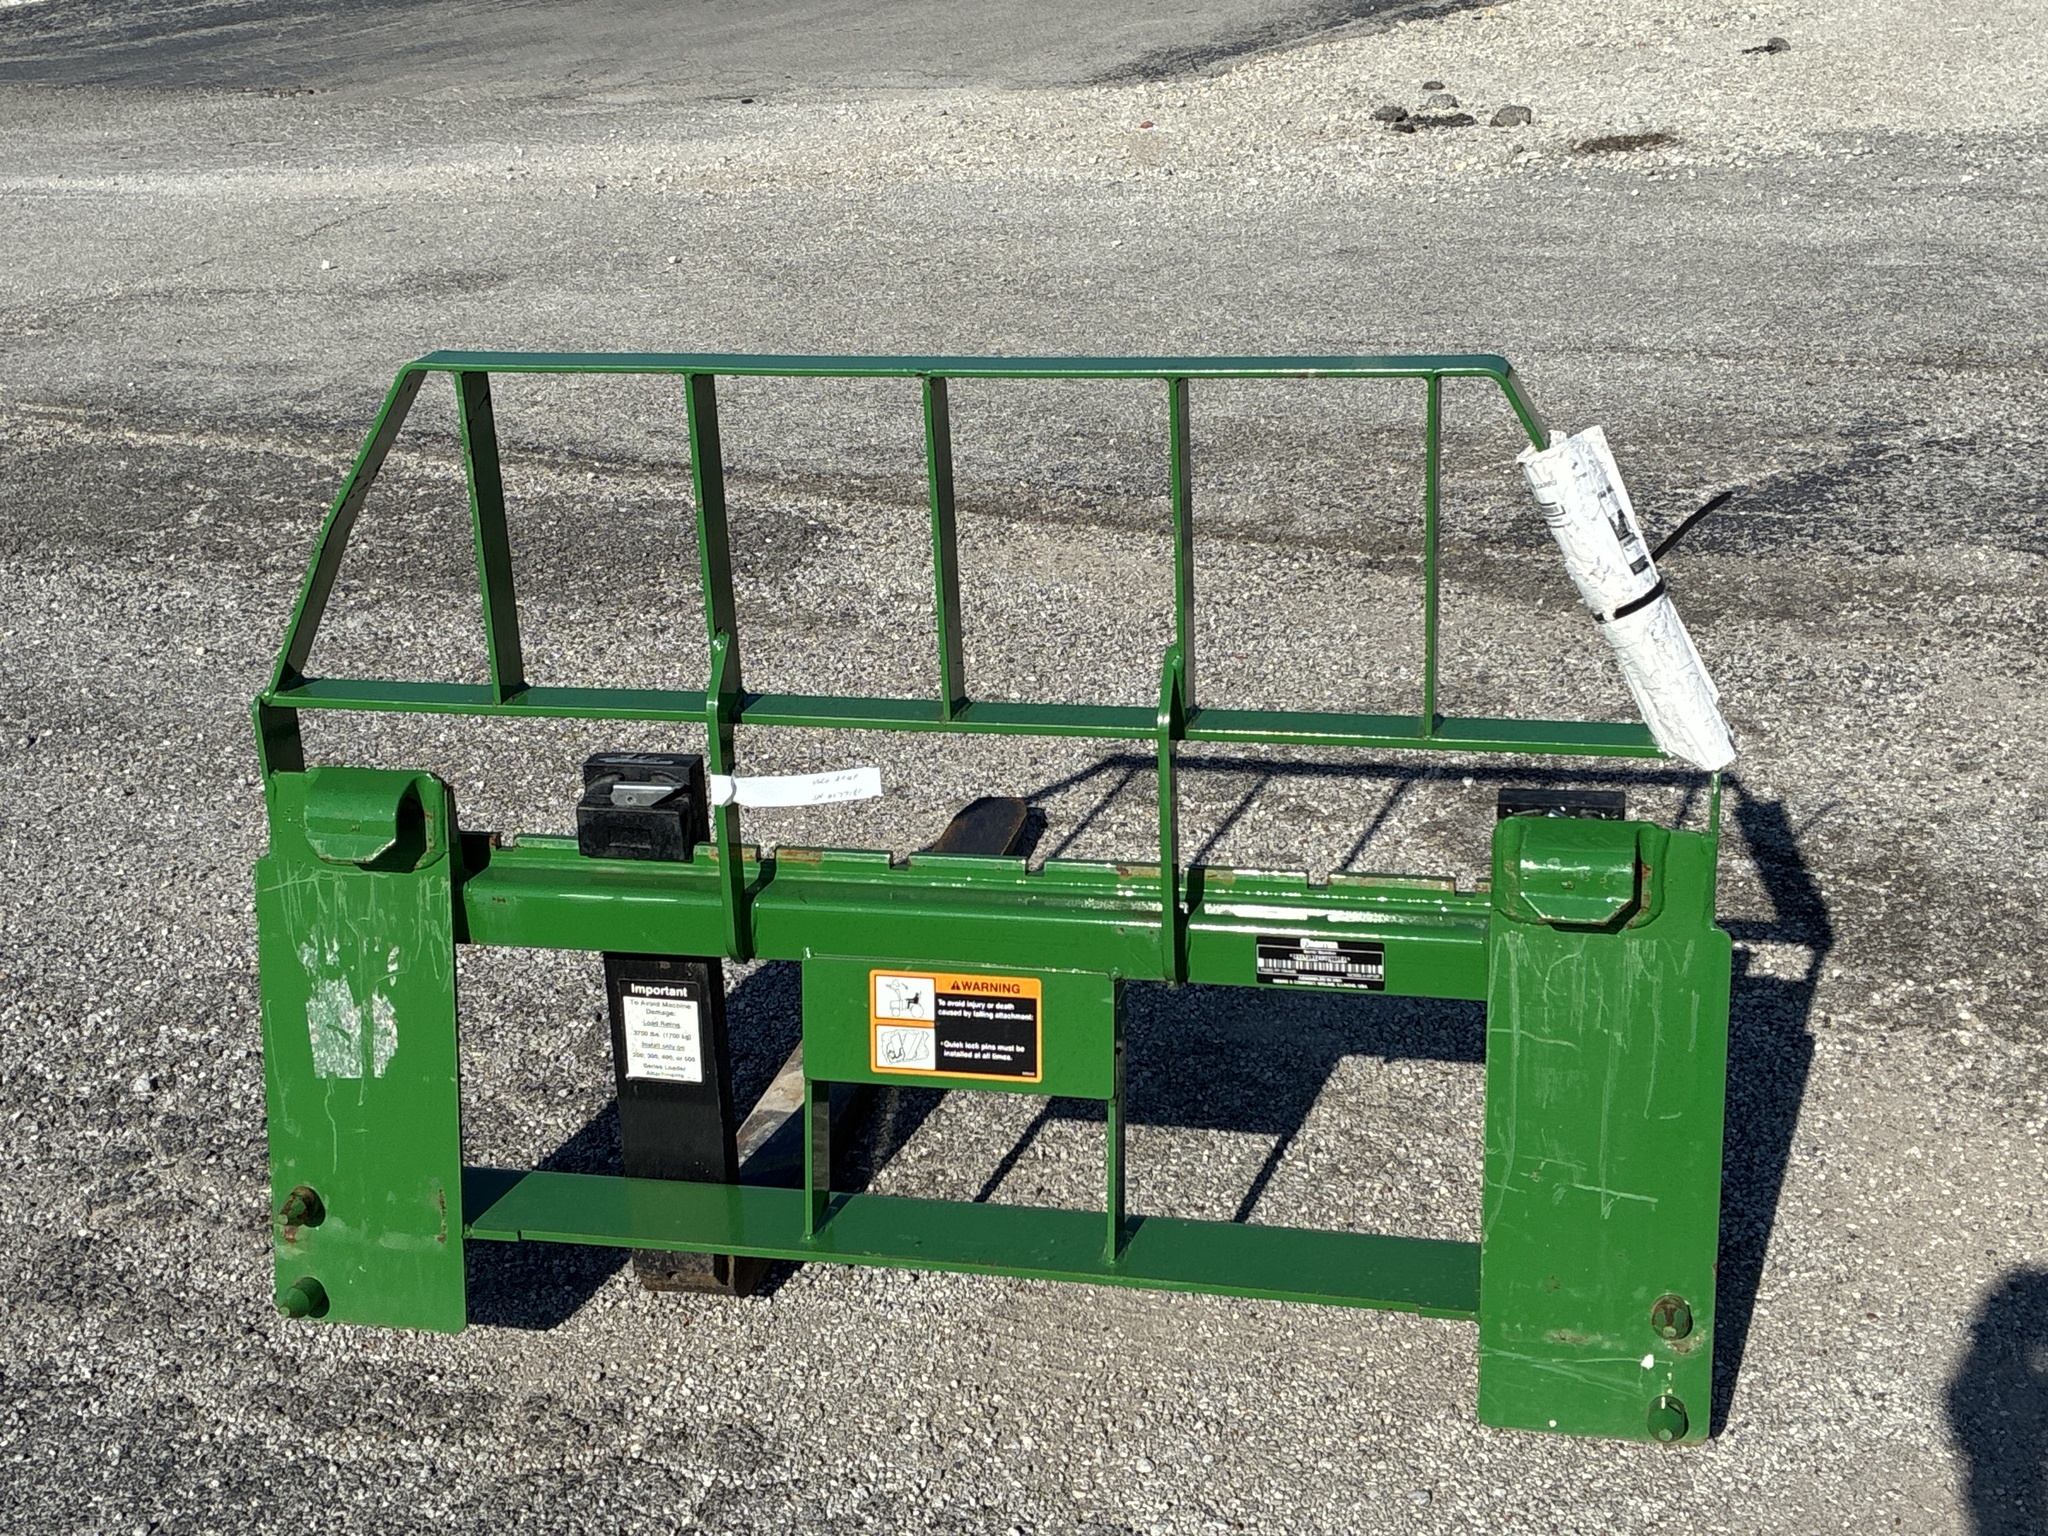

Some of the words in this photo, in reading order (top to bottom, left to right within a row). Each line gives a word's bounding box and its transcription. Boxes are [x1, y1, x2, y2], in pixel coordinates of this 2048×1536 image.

[631, 983, 688, 997] Important
[961, 981, 1021, 994] WARNING
[938, 998, 946, 1006] To
[947, 1000, 966, 1008] avoid
[967, 1001, 986, 1009] injury
[995, 1002, 1015, 1010] death
[938, 1009, 962, 1017] caused
[963, 1010, 972, 1019] by
[973, 1010, 994, 1020] falling
[943, 1040, 964, 1048] Quick
[965, 1041, 980, 1050] lock
[981, 1043, 996, 1052] pins
[997, 1044, 1015, 1052] must
[1016, 1045, 1025, 1053] be
[944, 1049, 973, 1058] installed
[992, 1053, 1013, 1061] times.
